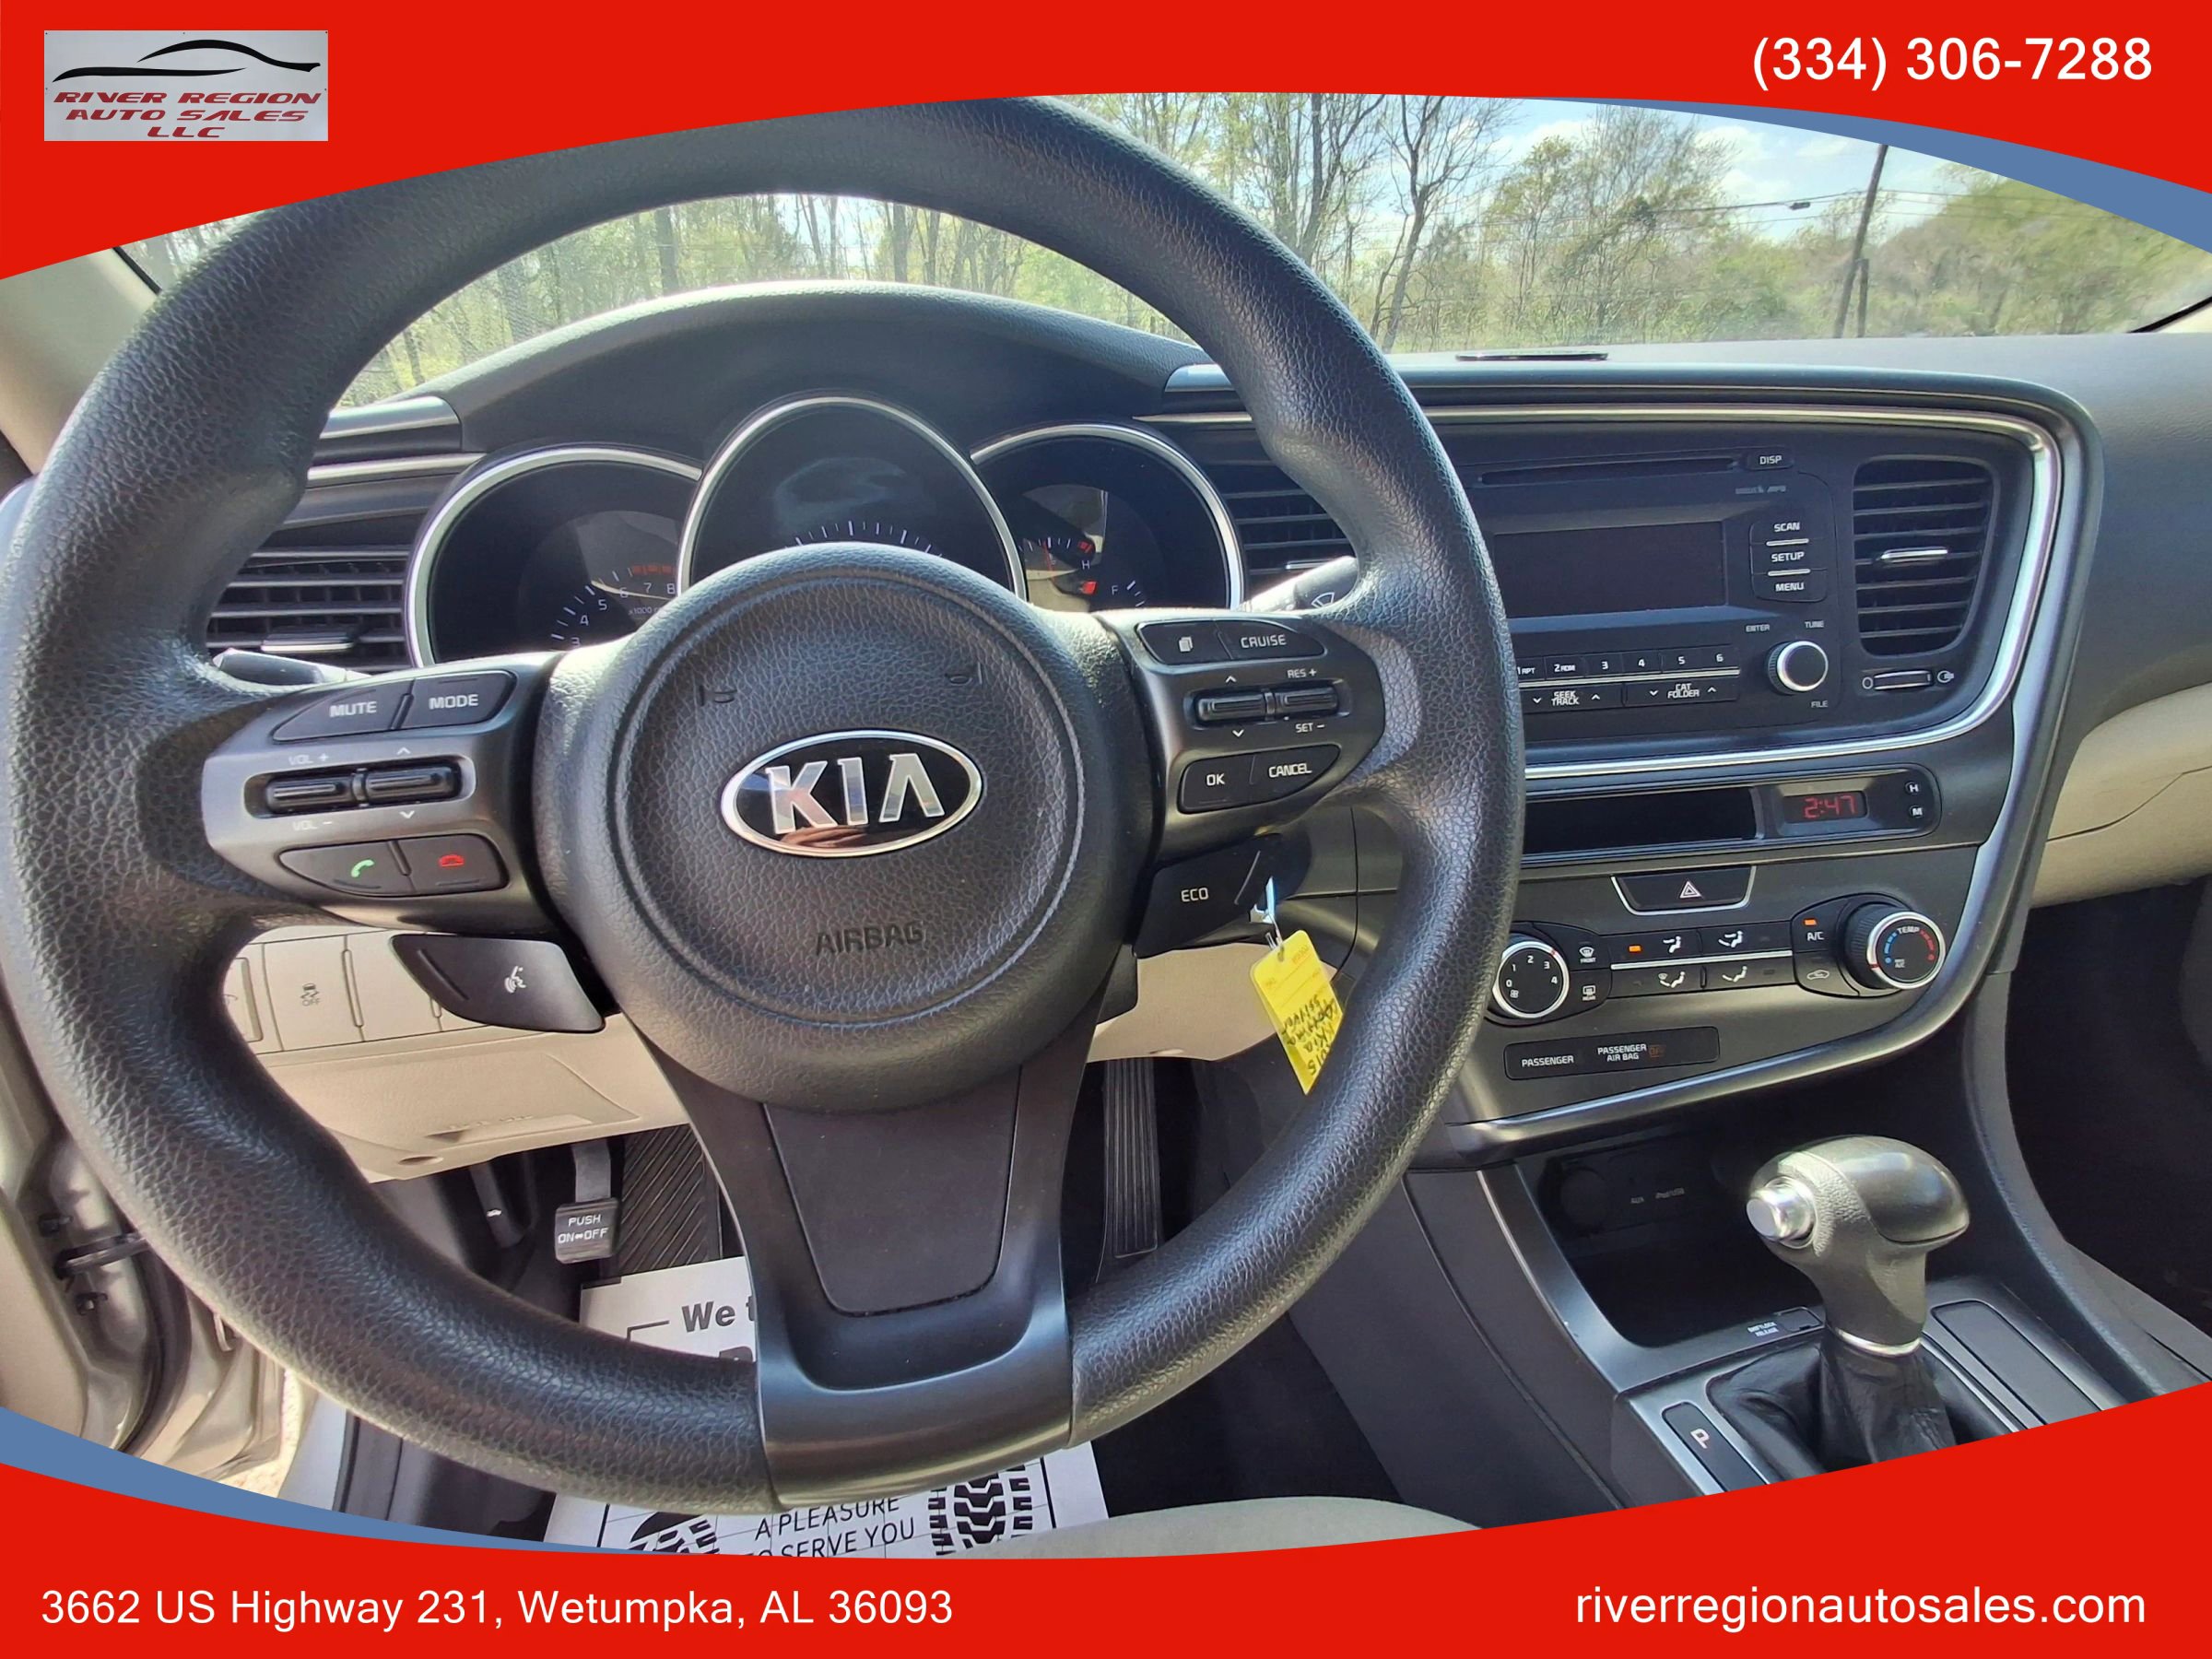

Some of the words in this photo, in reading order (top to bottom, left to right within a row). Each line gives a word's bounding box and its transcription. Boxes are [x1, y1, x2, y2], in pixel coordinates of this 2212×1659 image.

[1759, 454, 1783, 465] DISP
[1773, 522, 1801, 533] SCAN
[1771, 551, 1806, 562] SETUP
[1081, 559, 1090, 570] H
[643, 582, 653, 594] 7
[666, 582, 676, 594] 8
[1112, 584, 1119, 595] F
[1775, 582, 1806, 593] MENU
[598, 599, 607, 611] 5
[580, 614, 589, 626] 4
[1240, 633, 1287, 649] CRUISE
[1638, 658, 1646, 668] 4
[1677, 655, 1686, 665] 5
[1715, 653, 1724, 664] 6
[1601, 661, 1609, 671] 3
[1287, 668, 1308, 679] RES
[1675, 682, 1692, 691] CAT
[1553, 690, 1577, 700] SEEK
[1666, 688, 1700, 700] FOLDER
[429, 693, 479, 711] MODE
[1550, 696, 1580, 707] TRACK
[1810, 700, 1829, 709] FILE
[329, 700, 378, 717] MUTE
[1295, 722, 1313, 734] SET
[288, 754, 314, 766] VOL
[1267, 762, 1313, 779] CANCEL
[1206, 772, 1226, 787] OK
[764, 752, 946, 835] KIA
[1909, 784, 1920, 793] H
[1804, 794, 1857, 819] 2:47
[1912, 806, 1923, 816] M
[1180, 887, 1209, 903] ECO
[1896, 925, 1921, 935] TEMP
[815, 924, 924, 957] AIRBAG
[1806, 931, 1826, 942] A/C
[1527, 955, 1535, 964] 2
[1543, 960, 1551, 970] 3
[1550, 976, 1559, 984] 4
[1597, 1043, 1647, 1055] PASSENGER
[1521, 1054, 1575, 1068] PASSENGER
[1606, 1053, 1621, 1063] AIR
[1622, 1053, 1640, 1061] BAG
[568, 1214, 602, 1227] PUSH
[681, 1300, 736, 1334] We
[1689, 1428, 1712, 1450] P
[754, 1517, 772, 1542] A
[778, 1497, 900, 1536] PLEASURE
[781, 1530, 858, 1558] SERVE
[865, 1516, 915, 1548] YOU
